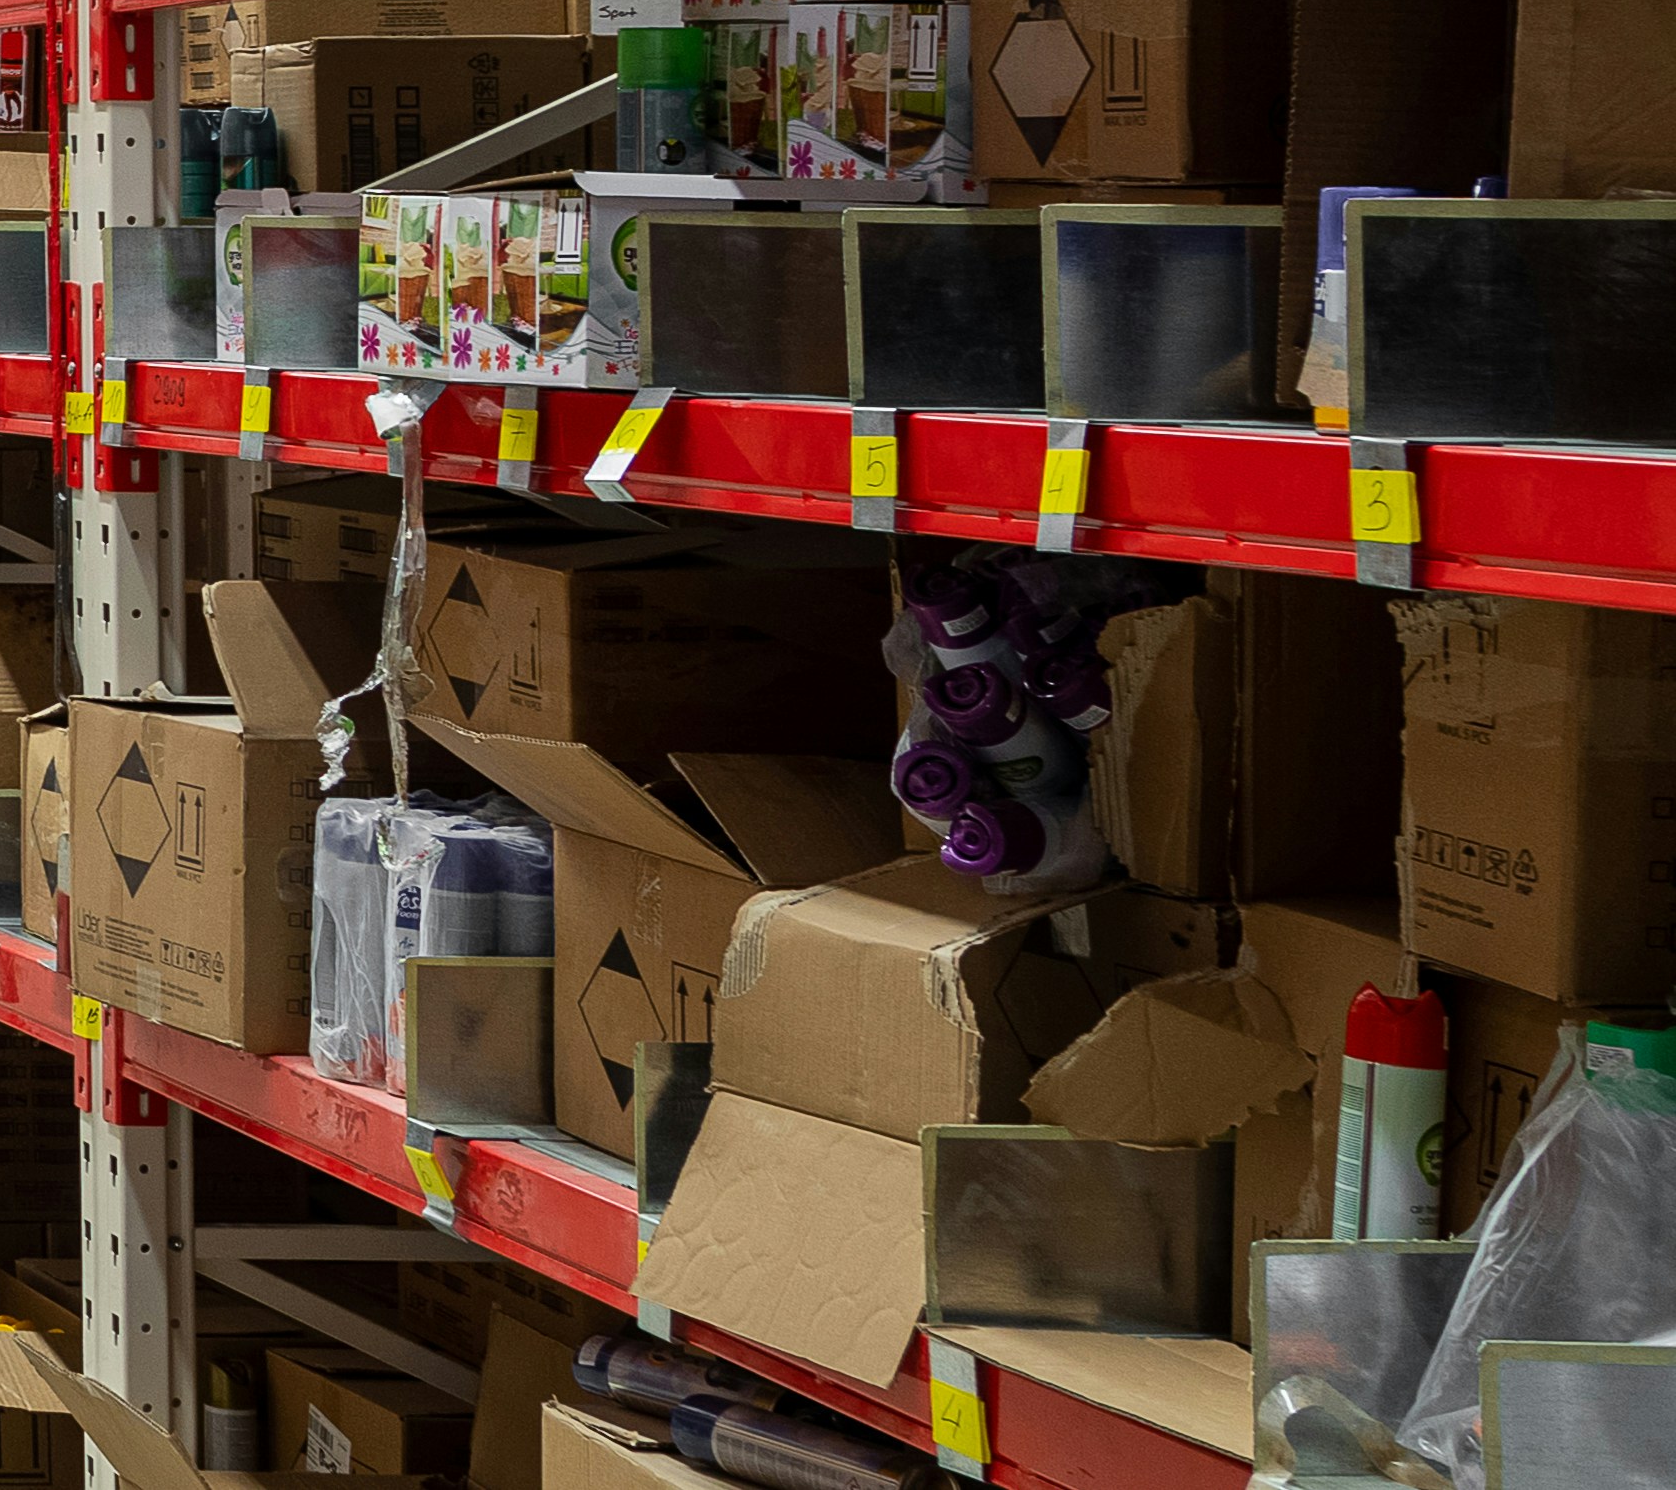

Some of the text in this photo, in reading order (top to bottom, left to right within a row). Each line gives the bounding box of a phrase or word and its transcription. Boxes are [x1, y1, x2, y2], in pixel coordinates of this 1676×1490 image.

[0, 68, 20, 78] SHOW
[244, 383, 261, 422] 9
[505, 412, 526, 456] 7
[615, 412, 646, 448] 6
[865, 443, 893, 488] 5
[1360, 480, 1391, 531] 3
[940, 1395, 960, 1438] 4
